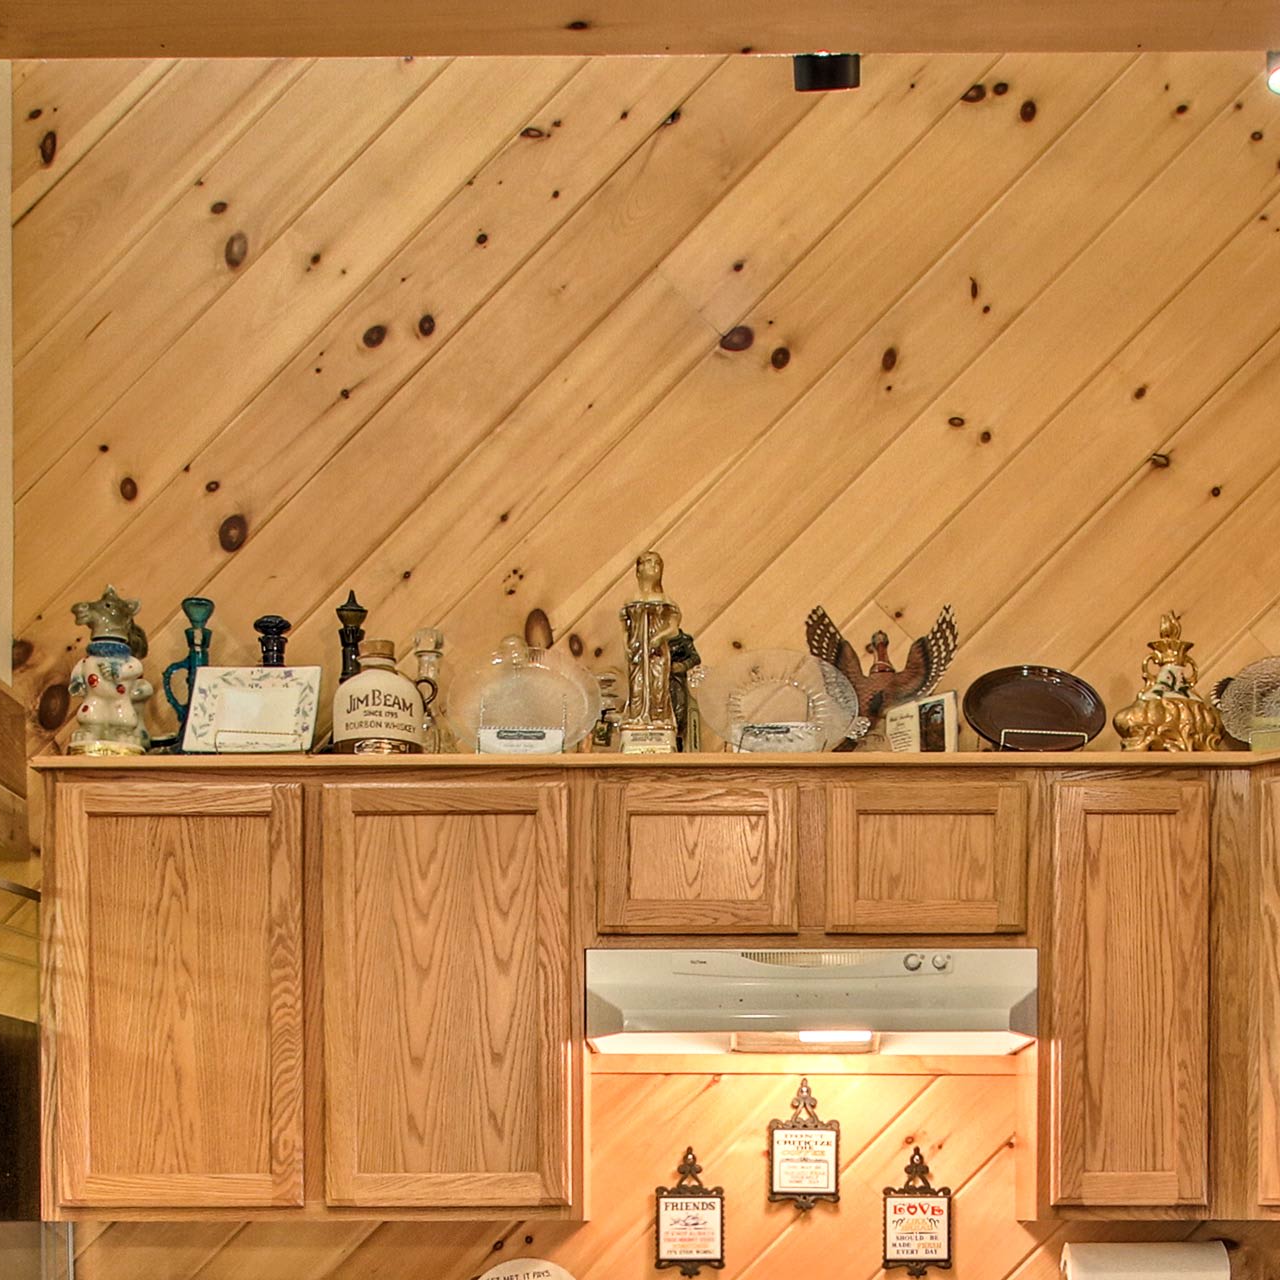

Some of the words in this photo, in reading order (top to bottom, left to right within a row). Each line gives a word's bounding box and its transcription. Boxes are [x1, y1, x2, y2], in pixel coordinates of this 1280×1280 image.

[346, 694, 370, 714] JIM
[371, 689, 414, 717] BEAM
[363, 710, 383, 718] SINCE
[345, 720, 382, 731] BOURBON
[383, 721, 416, 734] WHISKEY
[664, 1201, 716, 1211] FRIENDS
[893, 1202, 944, 1216] LOVE
[523, 1272, 530, 1280] IT
